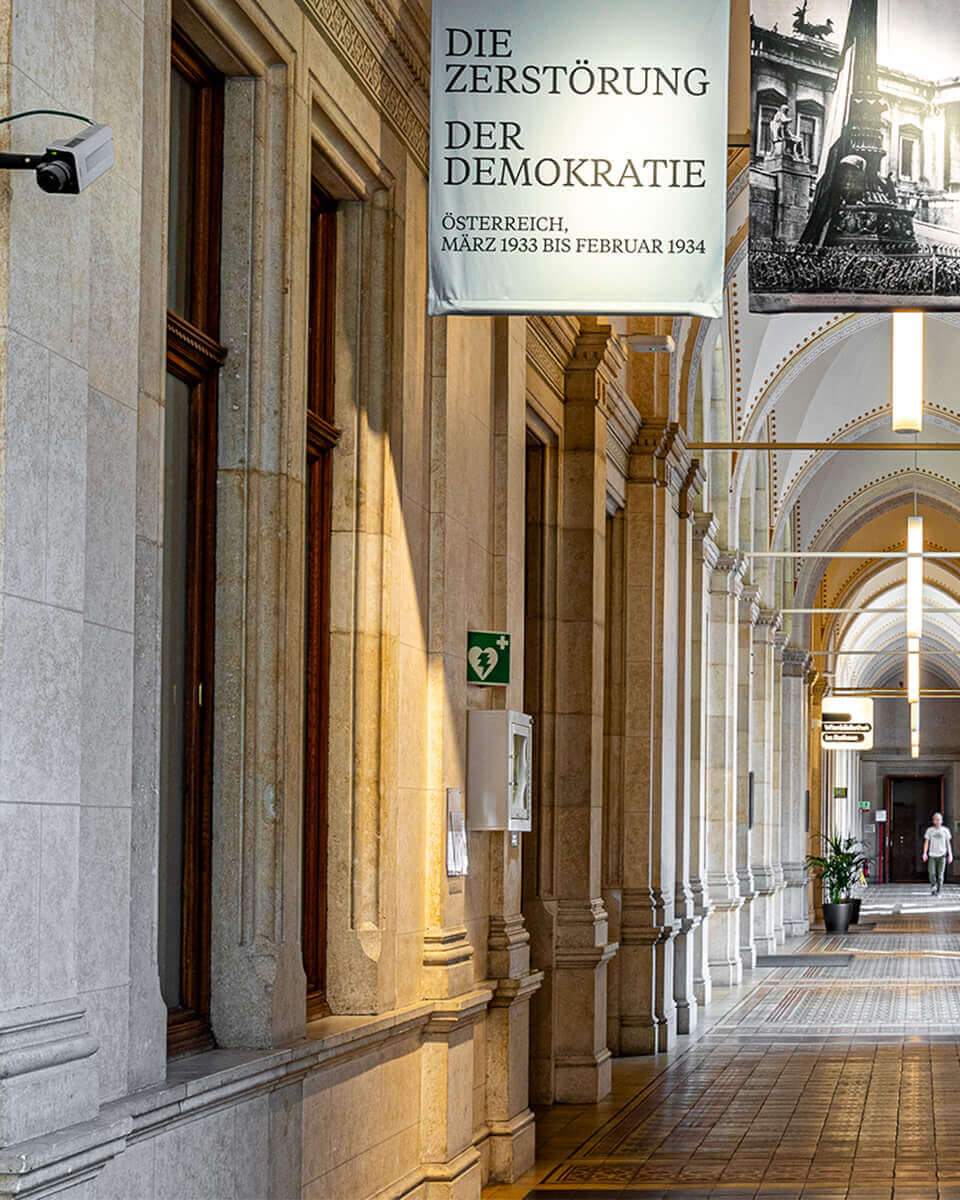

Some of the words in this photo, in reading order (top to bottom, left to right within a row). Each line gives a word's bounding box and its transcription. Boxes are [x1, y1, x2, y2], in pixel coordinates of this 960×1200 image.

[445, 28, 512, 57] DIE
[445, 60, 710, 96] ZERSTÖRUNG
[445, 121, 524, 150] DER
[444, 157, 705, 188] DEMOKRATIE
[442, 213, 568, 233] ÖSTERREICH,
[442, 234, 496, 252] MÄRZ
[501, 238, 538, 252] 1933
[543, 238, 571, 253] BIS
[576, 239, 663, 253] FEBRUAR
[668, 240, 705, 254] 1934
